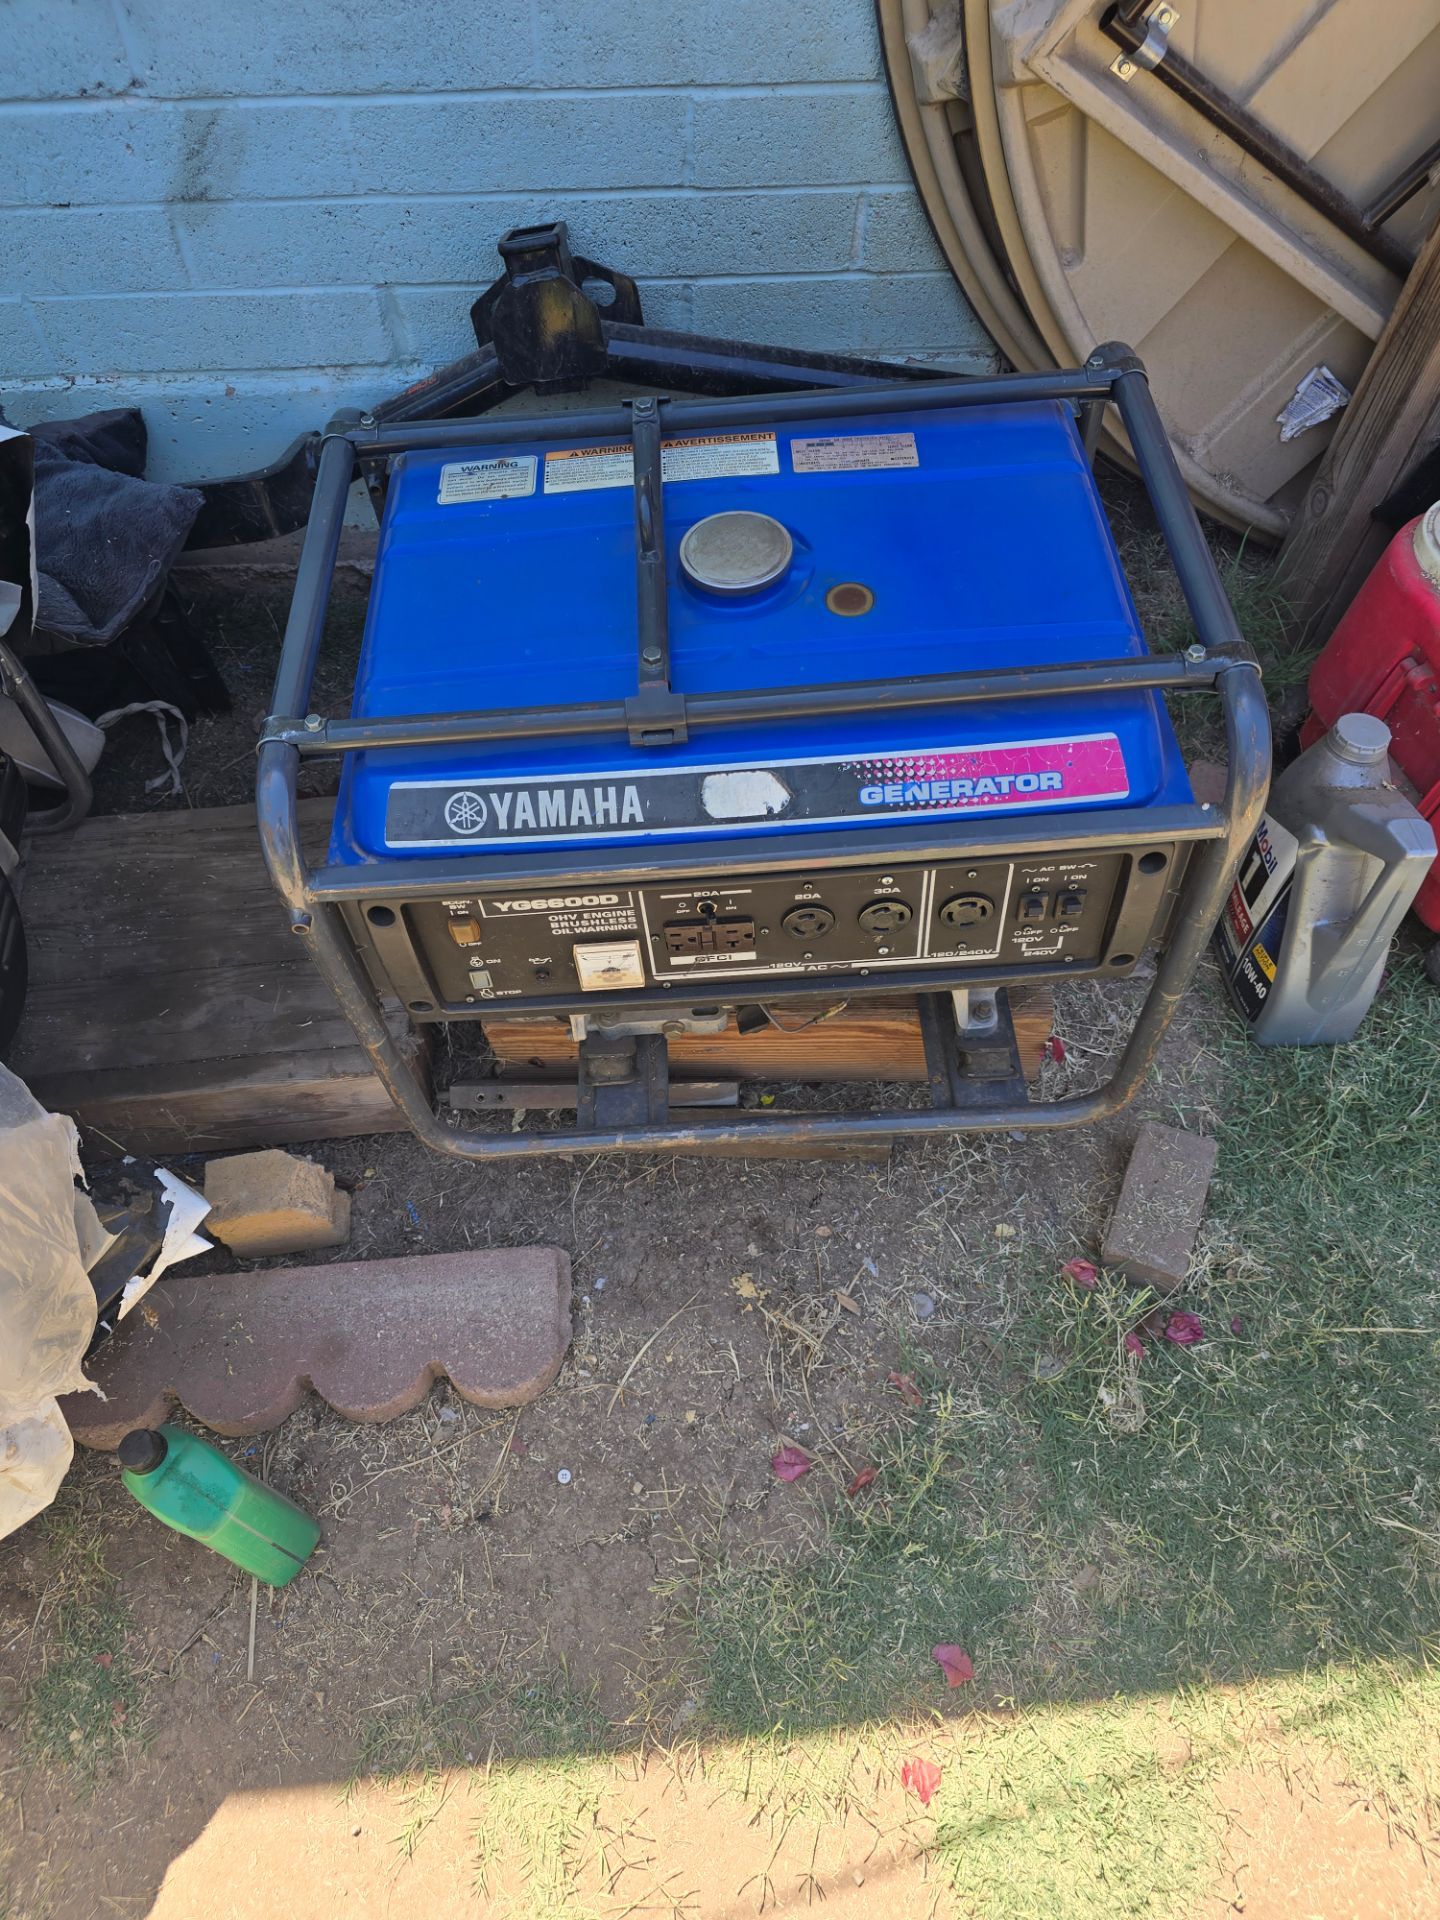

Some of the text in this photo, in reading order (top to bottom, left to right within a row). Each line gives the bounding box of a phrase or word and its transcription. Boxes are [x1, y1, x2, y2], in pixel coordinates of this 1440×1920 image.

[675, 433, 774, 446] AVERTISSEMENT
[461, 461, 518, 472] WARNING
[859, 771, 1063, 805] GENERATOR
[489, 785, 645, 830] YAMAHA
[1256, 819, 1278, 875] Mobil
[1241, 853, 1261, 891] 1
[693, 890, 720, 898] 20A
[794, 892, 821, 900] 20A
[873, 887, 901, 895] 30A
[492, 894, 618, 911] YG6600D
[548, 909, 635, 921] OHV ENGINE
[550, 916, 636, 928] BRUSHLESS
[551, 923, 638, 935] OIL WARNING
[930, 949, 993, 958] 120/240V
[1242, 957, 1267, 999] 10W-40
